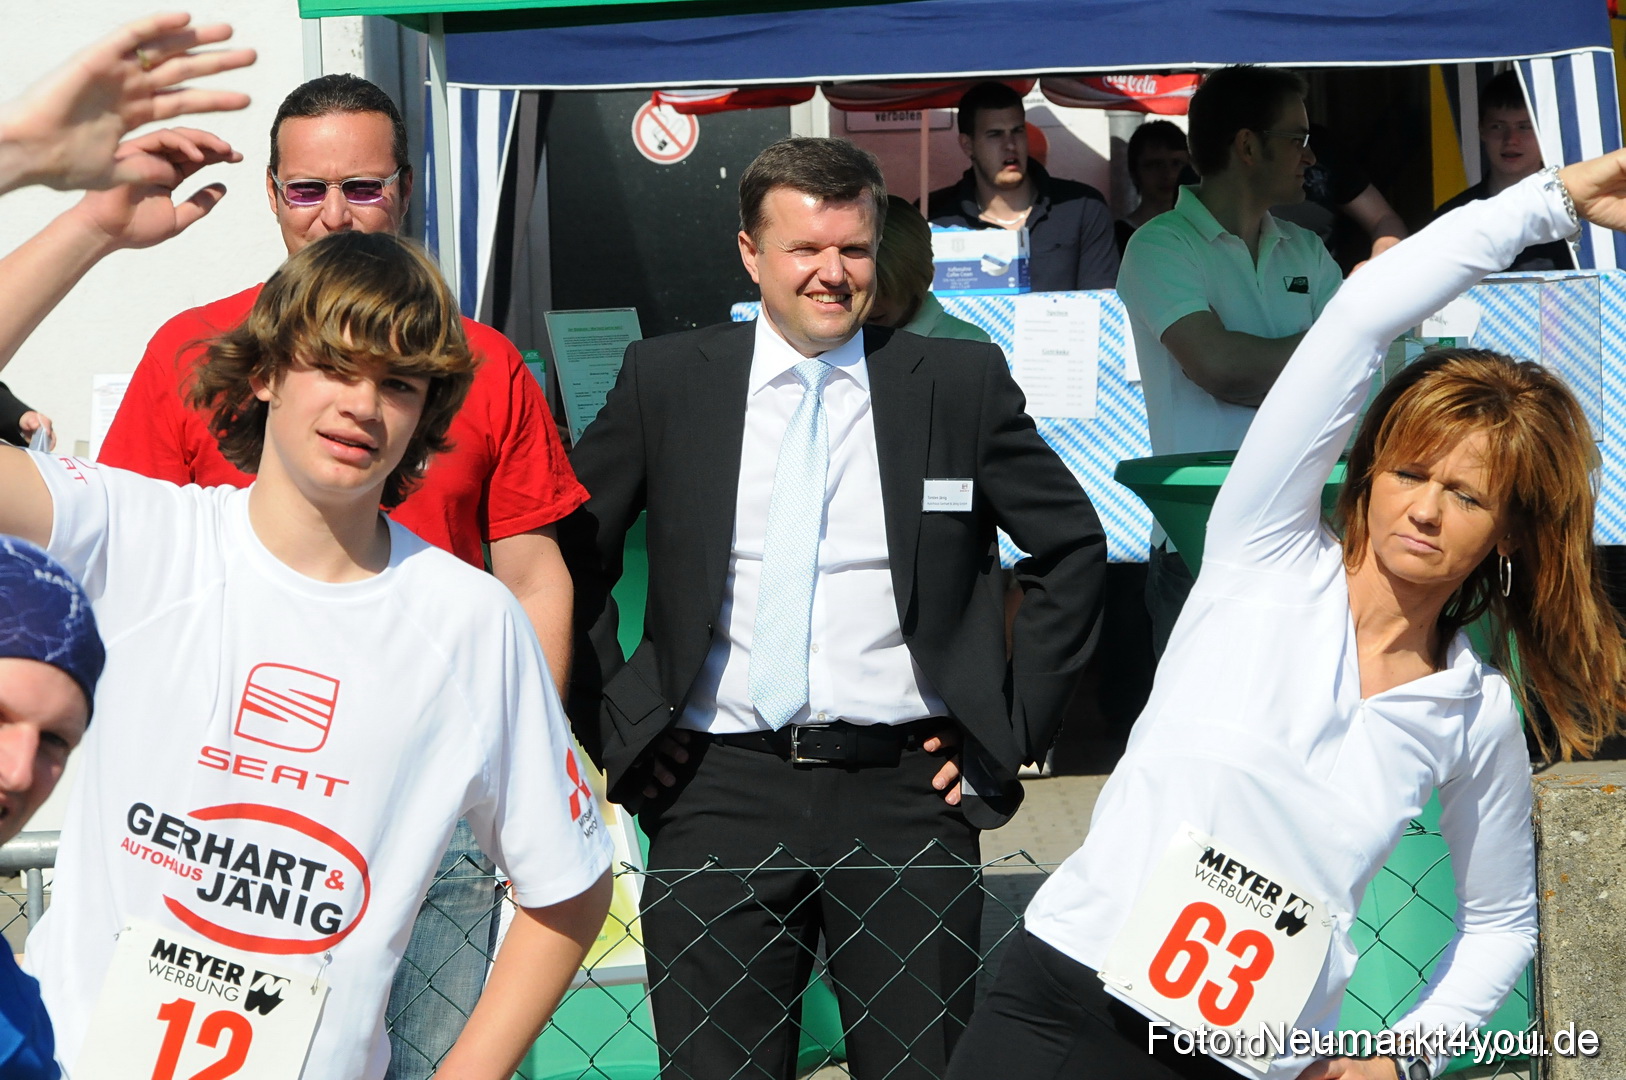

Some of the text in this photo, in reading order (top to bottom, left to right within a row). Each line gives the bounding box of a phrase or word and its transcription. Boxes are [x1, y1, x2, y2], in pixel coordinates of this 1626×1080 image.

[197, 745, 350, 798] SEAT
[120, 836, 204, 883] AUTOHAUS
[126, 801, 345, 895] GERHART &
[1198, 846, 1283, 906] MEYER
[196, 871, 345, 936] JÄNIG
[1194, 864, 1274, 919] WERBUNG
[148, 958, 240, 1003] WERBUNG
[150, 937, 246, 987] MEYER
[1147, 901, 1275, 1027] 63
[150, 997, 253, 1080] 12
